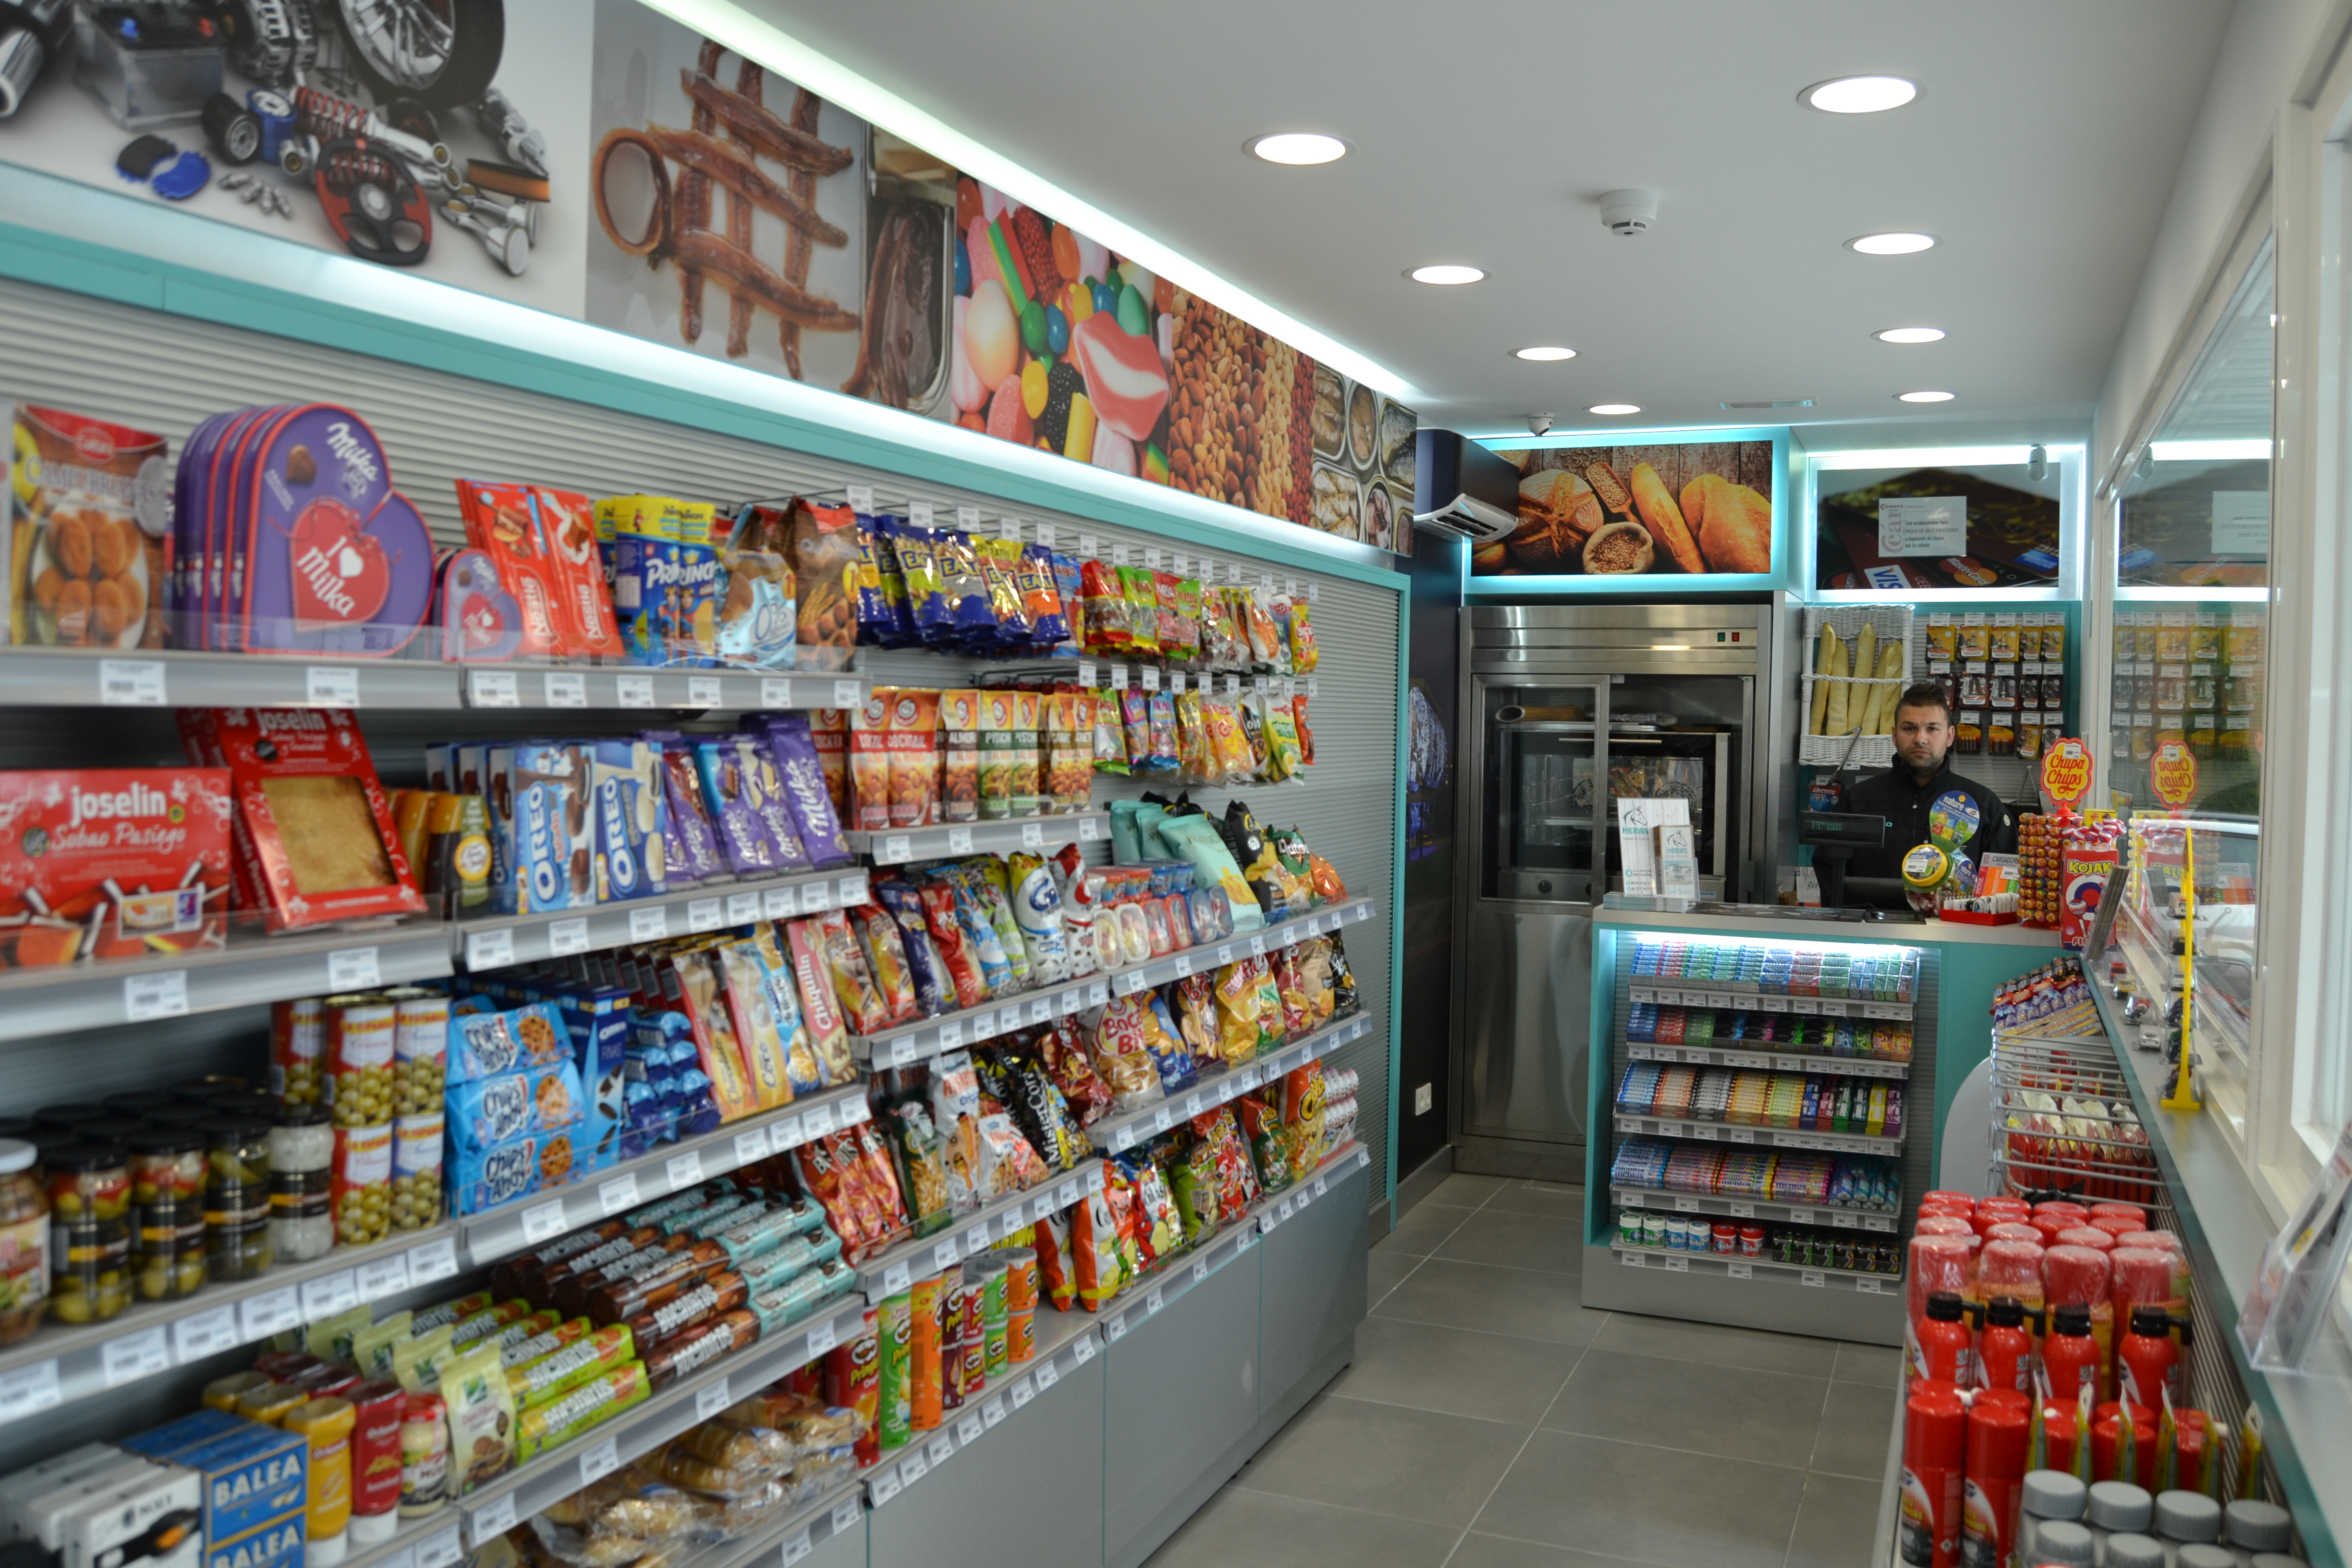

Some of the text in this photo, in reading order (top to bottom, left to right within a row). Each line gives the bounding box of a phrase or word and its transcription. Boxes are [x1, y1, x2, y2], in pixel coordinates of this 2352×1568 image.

[327, 422, 379, 482] Milka
[296, 546, 356, 617] Milka
[1946, 557, 1991, 585] MasterCard
[2047, 770, 2082, 793] Chups
[2050, 754, 2085, 773] Chupa
[70, 780, 167, 828] joselin
[1943, 795, 1965, 811] nature
[52, 823, 110, 851] Sobao
[115, 821, 187, 855] Pasiego
[527, 784, 557, 902] OREO
[602, 776, 634, 888] OREO
[214, 1454, 303, 1507] BALEA
